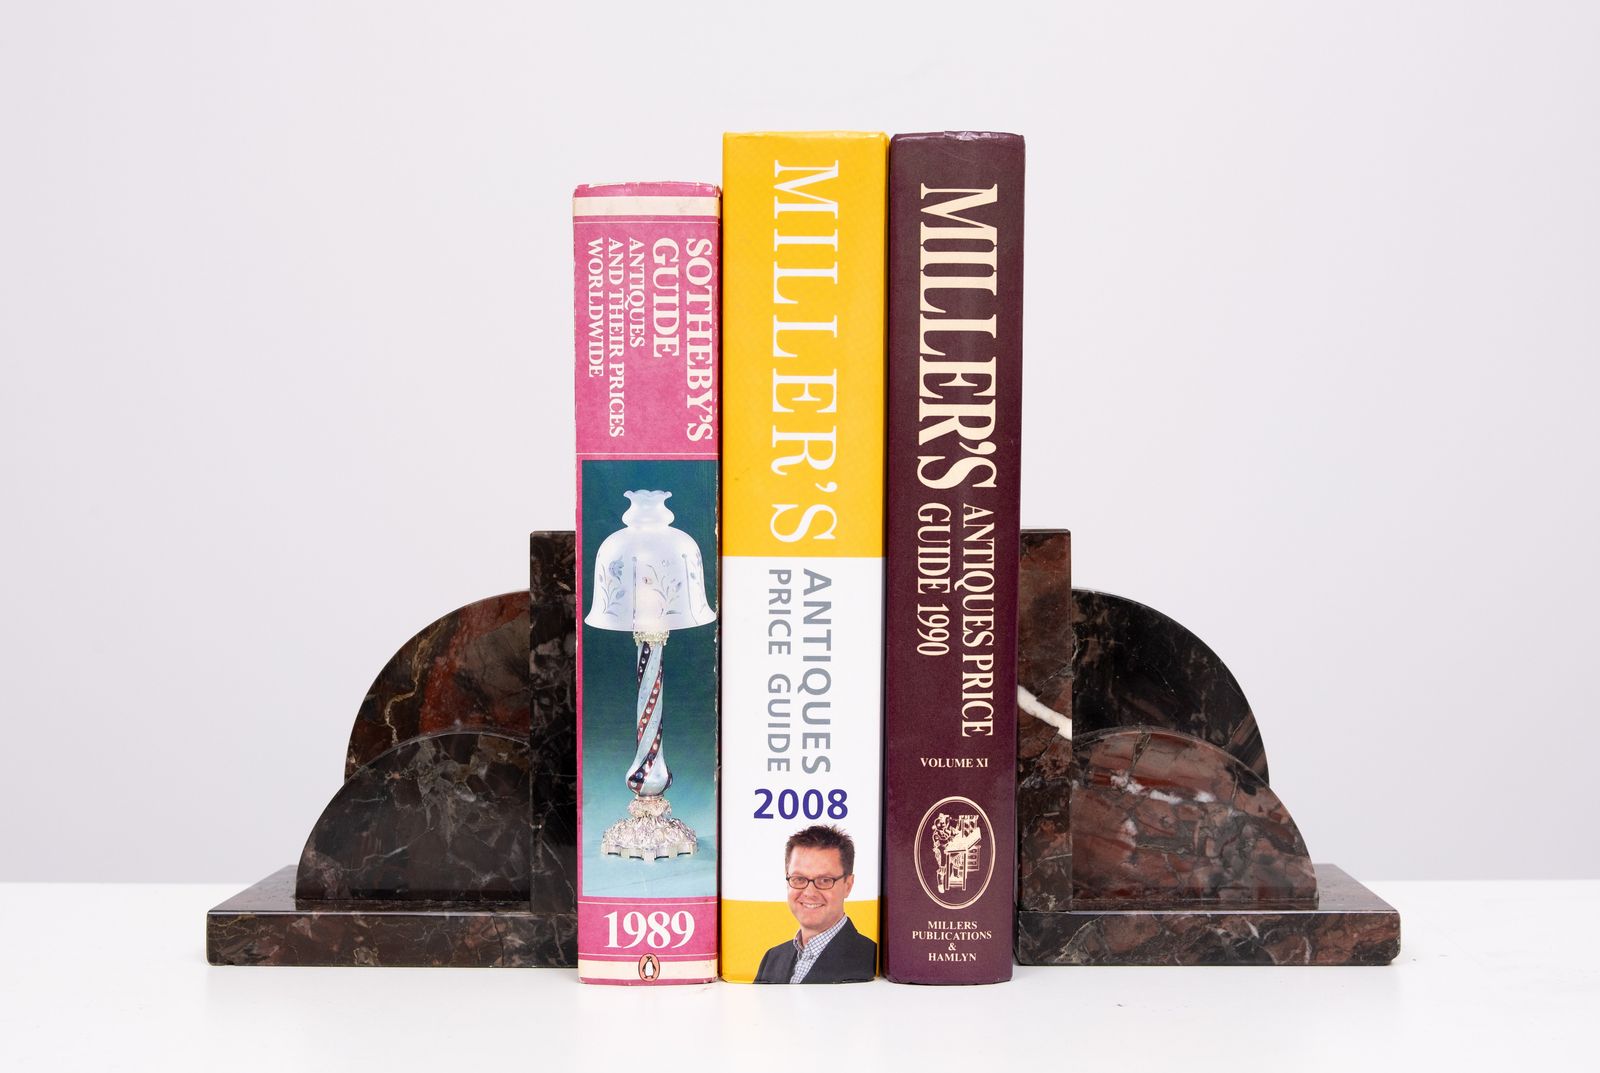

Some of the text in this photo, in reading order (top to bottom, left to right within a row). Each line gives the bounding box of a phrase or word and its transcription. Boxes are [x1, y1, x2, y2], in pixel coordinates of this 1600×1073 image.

[587, 237, 604, 378] WORLDWIDE
[608, 237, 625, 438] AND THEIR PRICES
[624, 237, 645, 348] ANTIQUES
[652, 237, 680, 358] GUIDE
[685, 238, 713, 442] SOTHEBY'S
[770, 159, 839, 543] MILLER'S
[917, 182, 998, 490] MILLER'S
[916, 502, 952, 656] GUIDE 1990
[954, 503, 995, 738] ANTIQUES PRICE
[767, 569, 792, 772] PRICE GUIDE
[797, 568, 832, 775] ANTIQUES
[753, 788, 848, 820] 2008
[920, 757, 989, 768] VOLUME XI
[603, 910, 695, 949] 1989
[912, 930, 992, 941] PUBLICATIONS
[927, 920, 978, 930] MILLERS
[928, 952, 977, 962] HAMLYN
[948, 942, 957, 951] &
